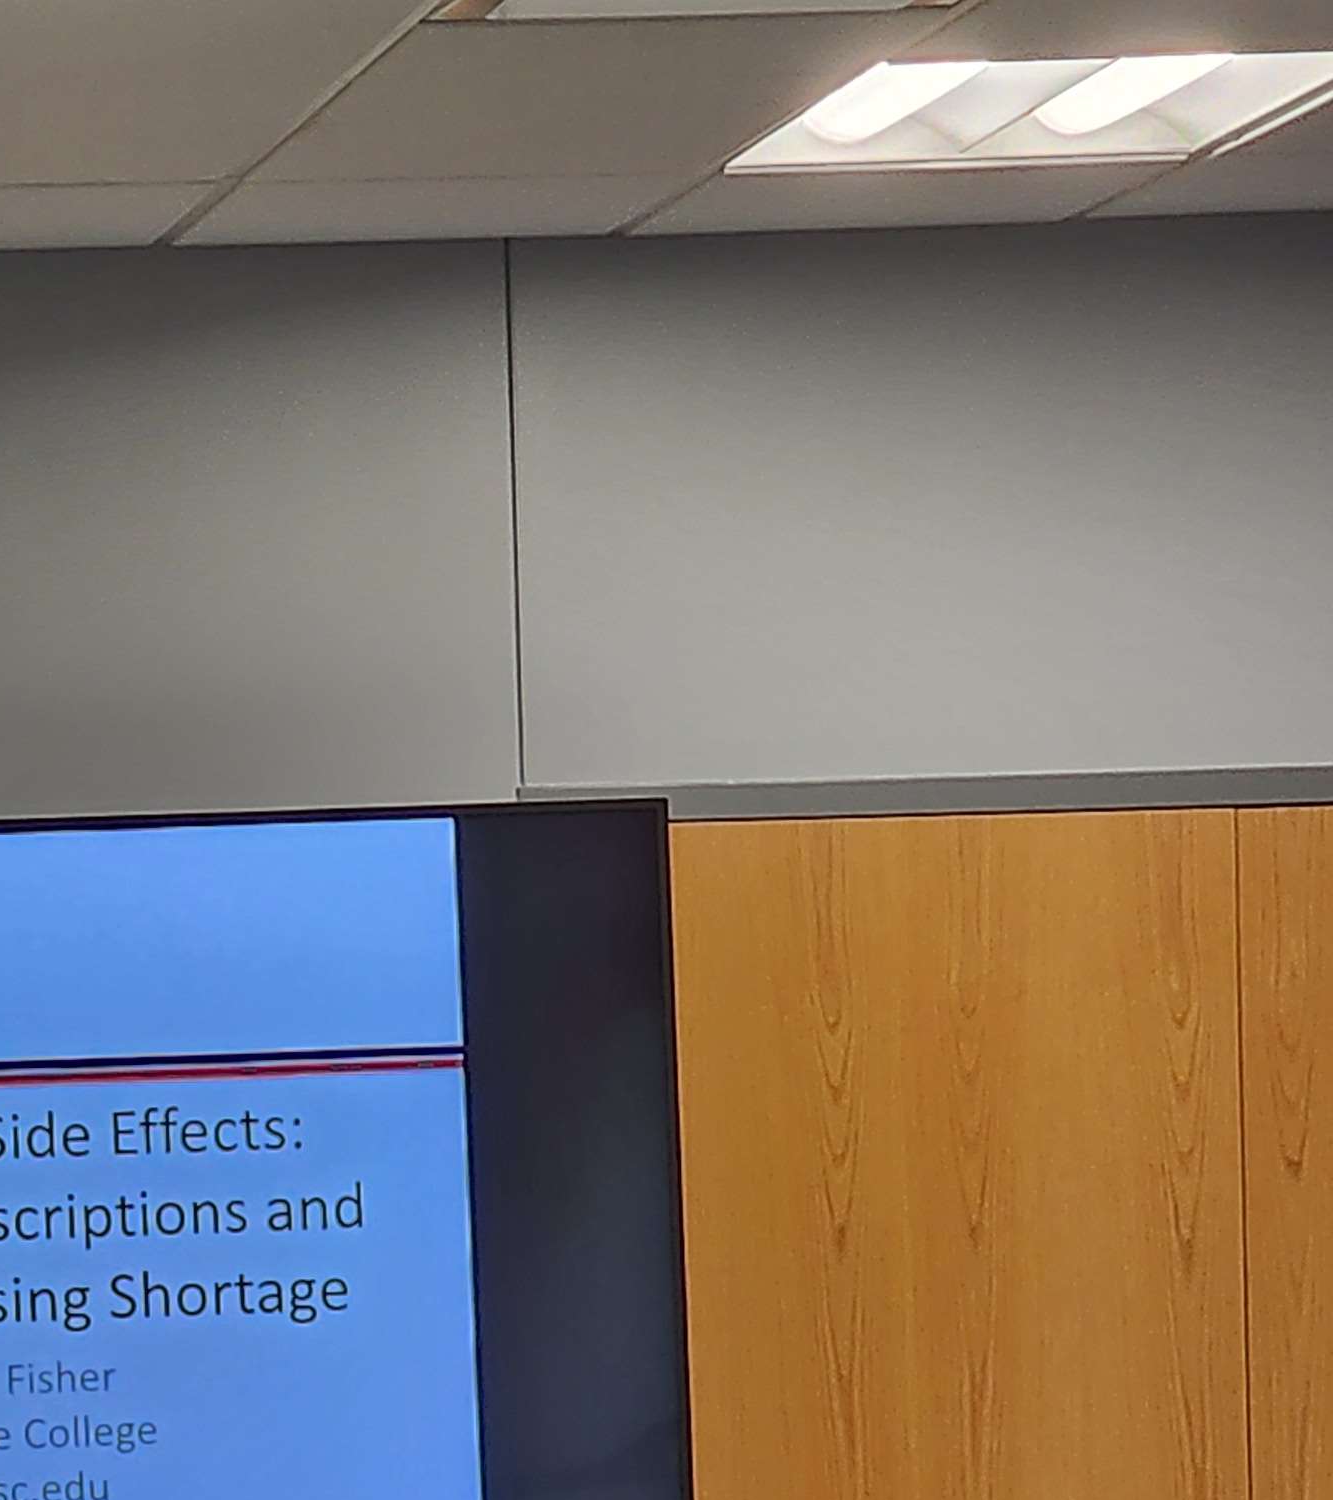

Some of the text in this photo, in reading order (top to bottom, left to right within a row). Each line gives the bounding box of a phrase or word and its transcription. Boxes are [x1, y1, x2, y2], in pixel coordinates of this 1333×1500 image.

[112, 1106, 304, 1155] Effects:
[267, 1181, 365, 1231] and
[110, 1270, 349, 1324] Shortage
[7, 1360, 117, 1395] Fisher
[24, 1415, 159, 1455] College
